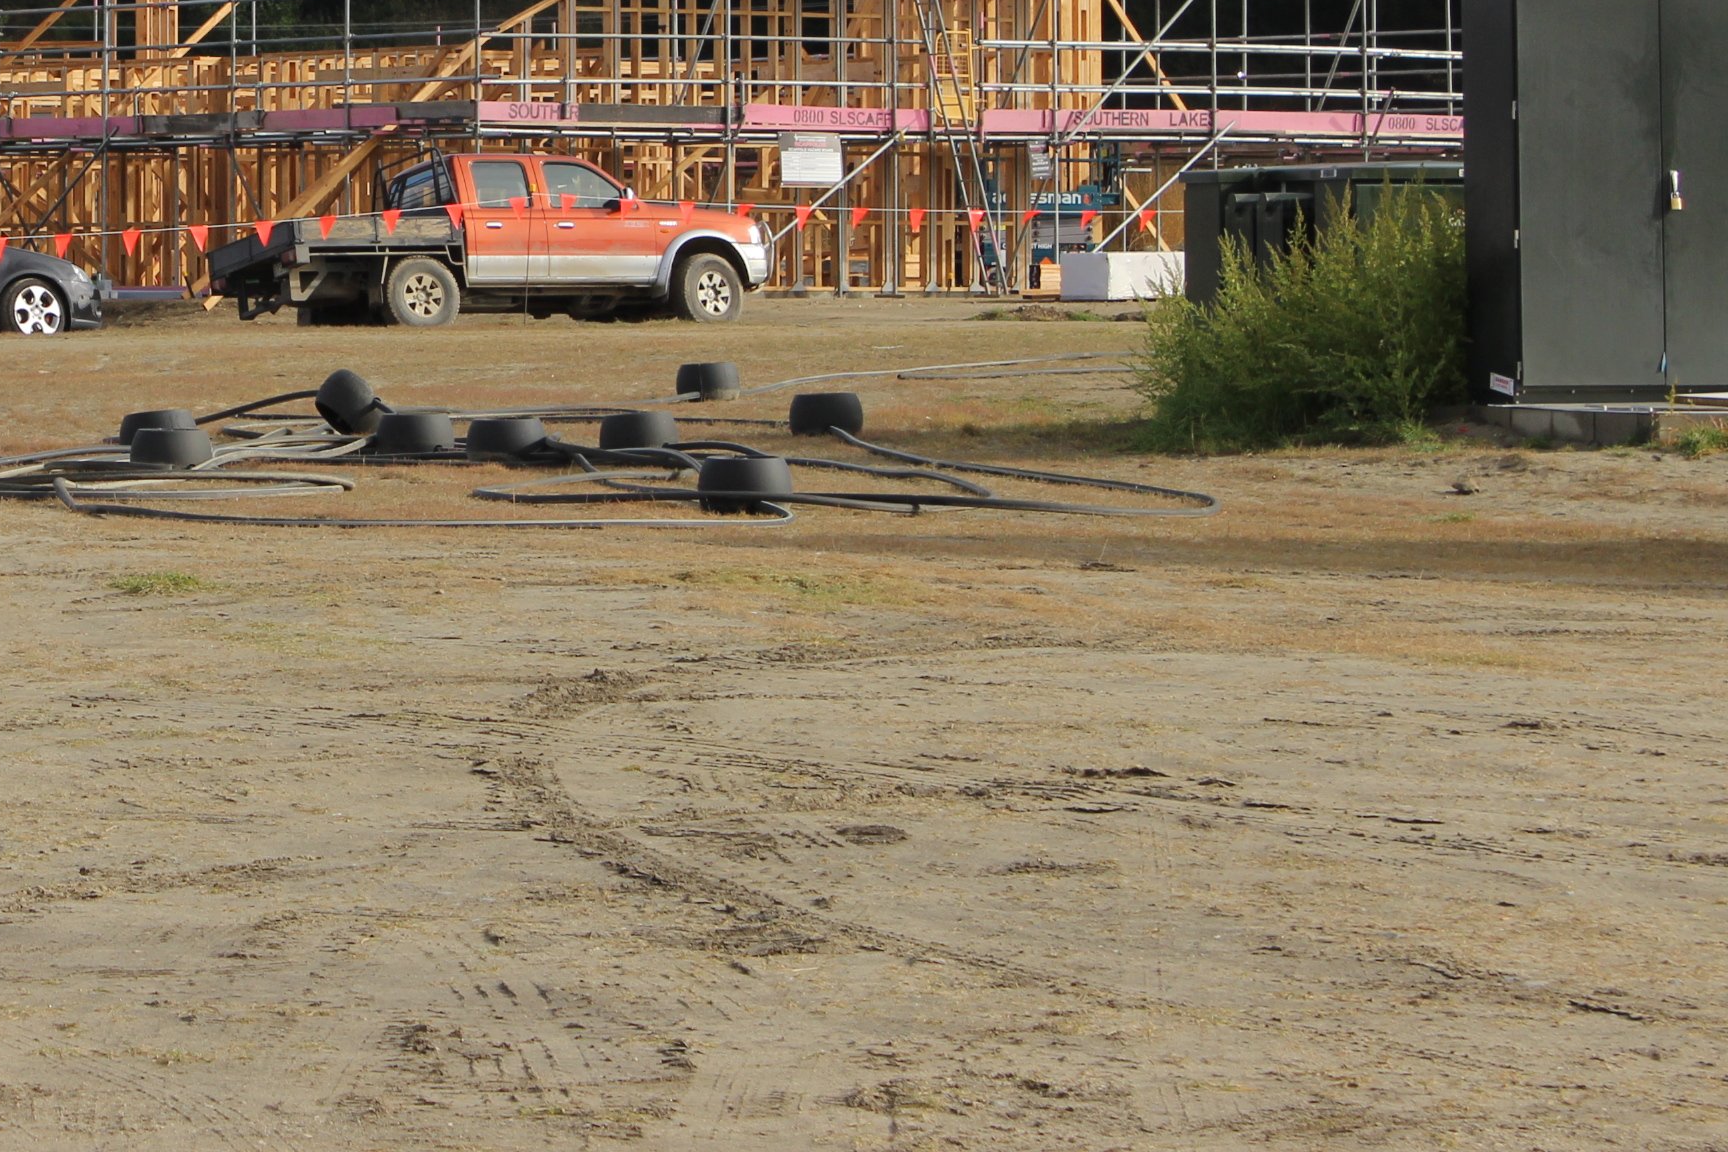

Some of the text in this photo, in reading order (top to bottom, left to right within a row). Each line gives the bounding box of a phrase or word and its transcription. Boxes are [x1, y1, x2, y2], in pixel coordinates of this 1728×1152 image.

[793, 109, 891, 126] 0800 SLSCAFF
[1073, 111, 1149, 126] SOUTHERN
[1388, 117, 1416, 130] 0800
